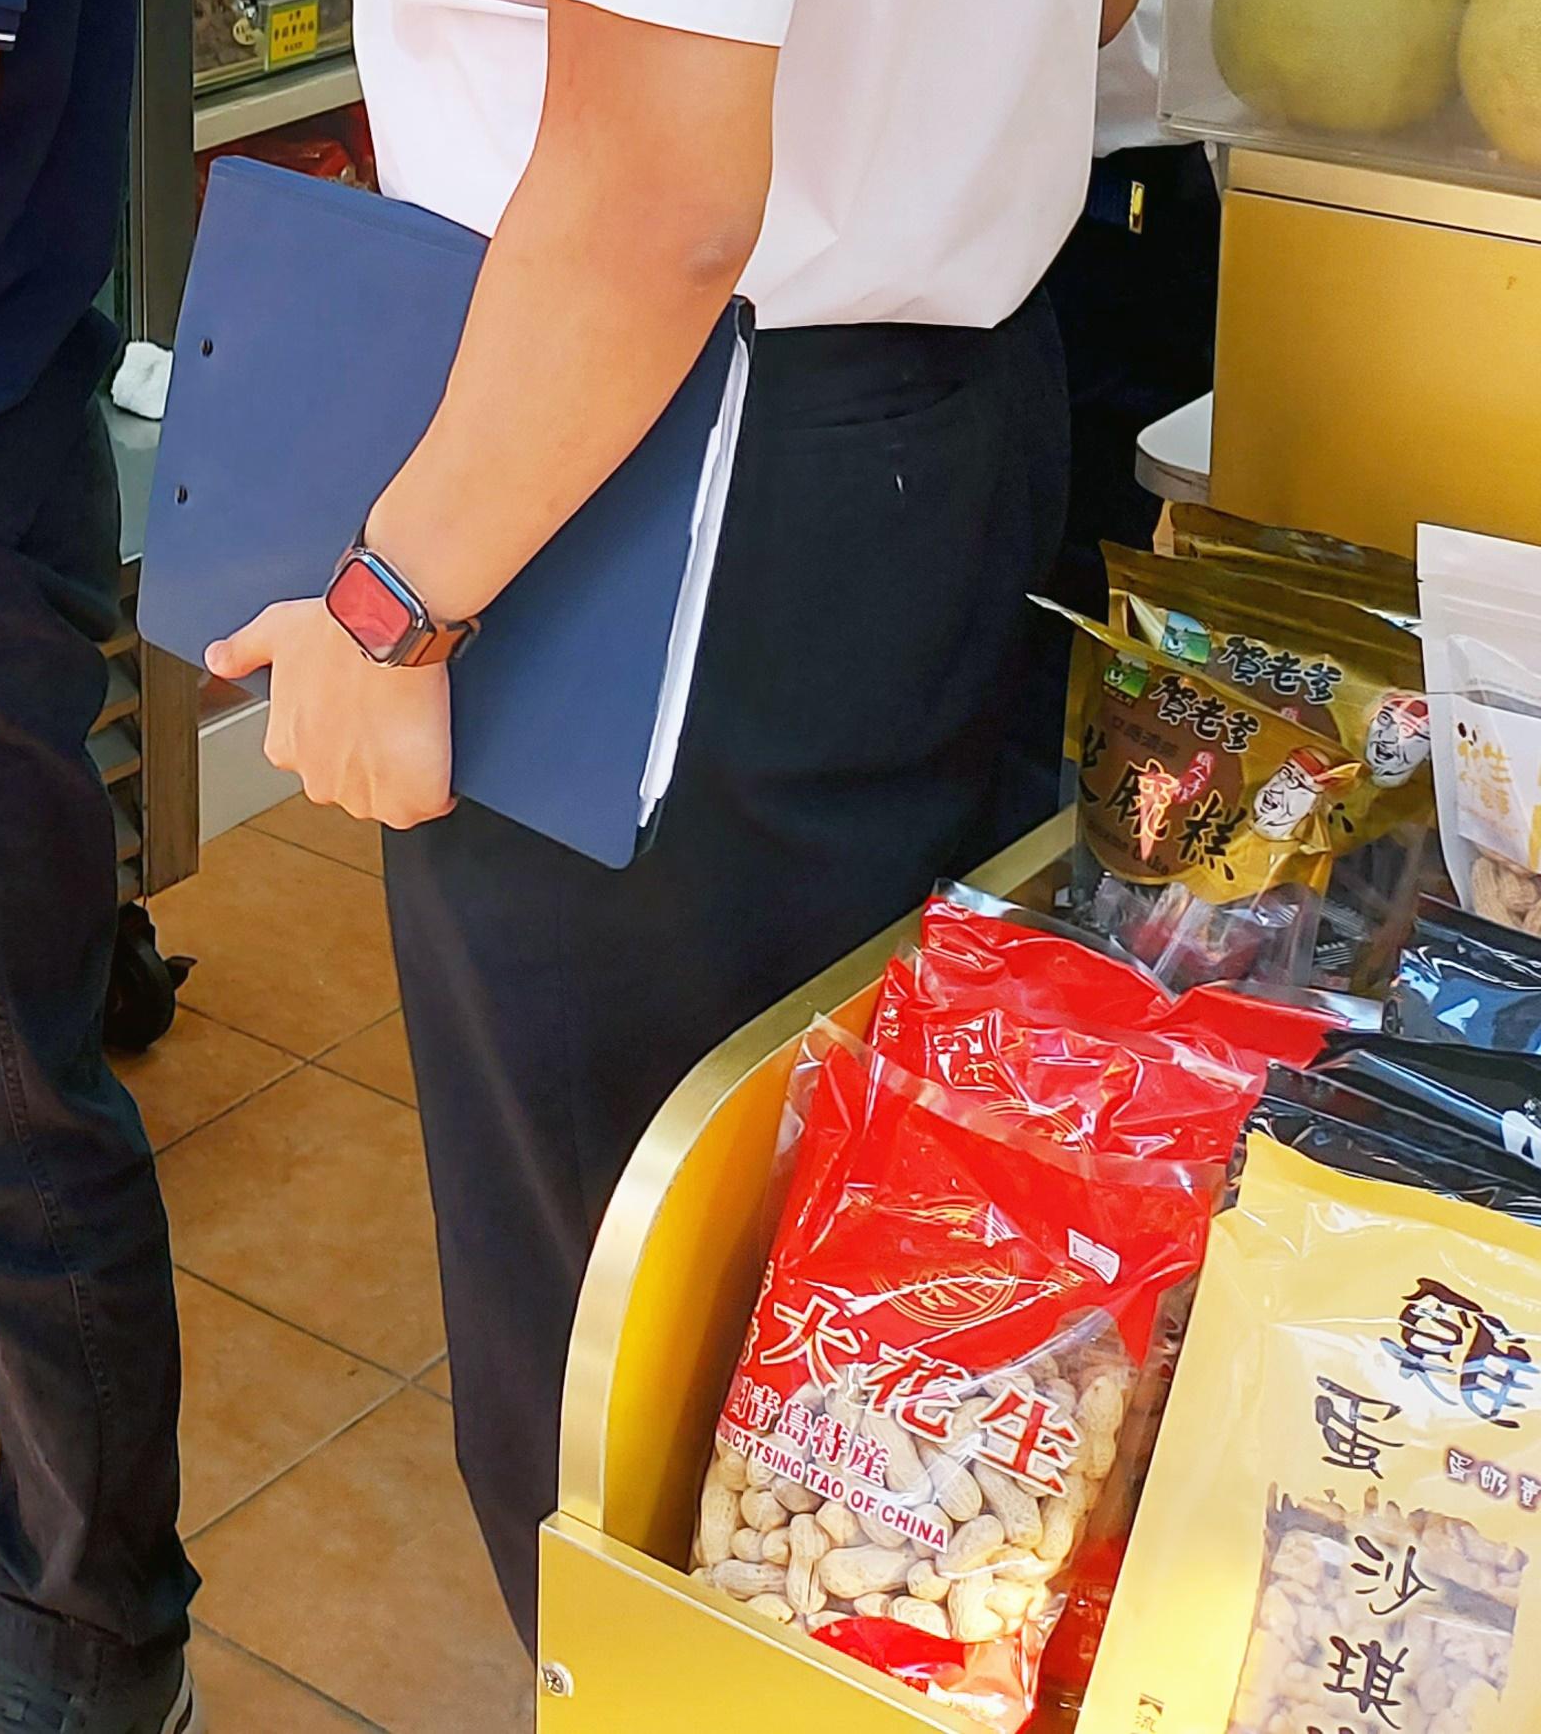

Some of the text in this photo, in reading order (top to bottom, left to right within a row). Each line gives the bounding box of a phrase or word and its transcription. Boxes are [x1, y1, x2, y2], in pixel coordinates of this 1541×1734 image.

[760, 1295, 1082, 1498] 大花生
[753, 1438, 805, 1478] TSING
[806, 1467, 846, 1503] TAO
[849, 1489, 878, 1514] OF
[880, 1502, 948, 1553] CHINA
